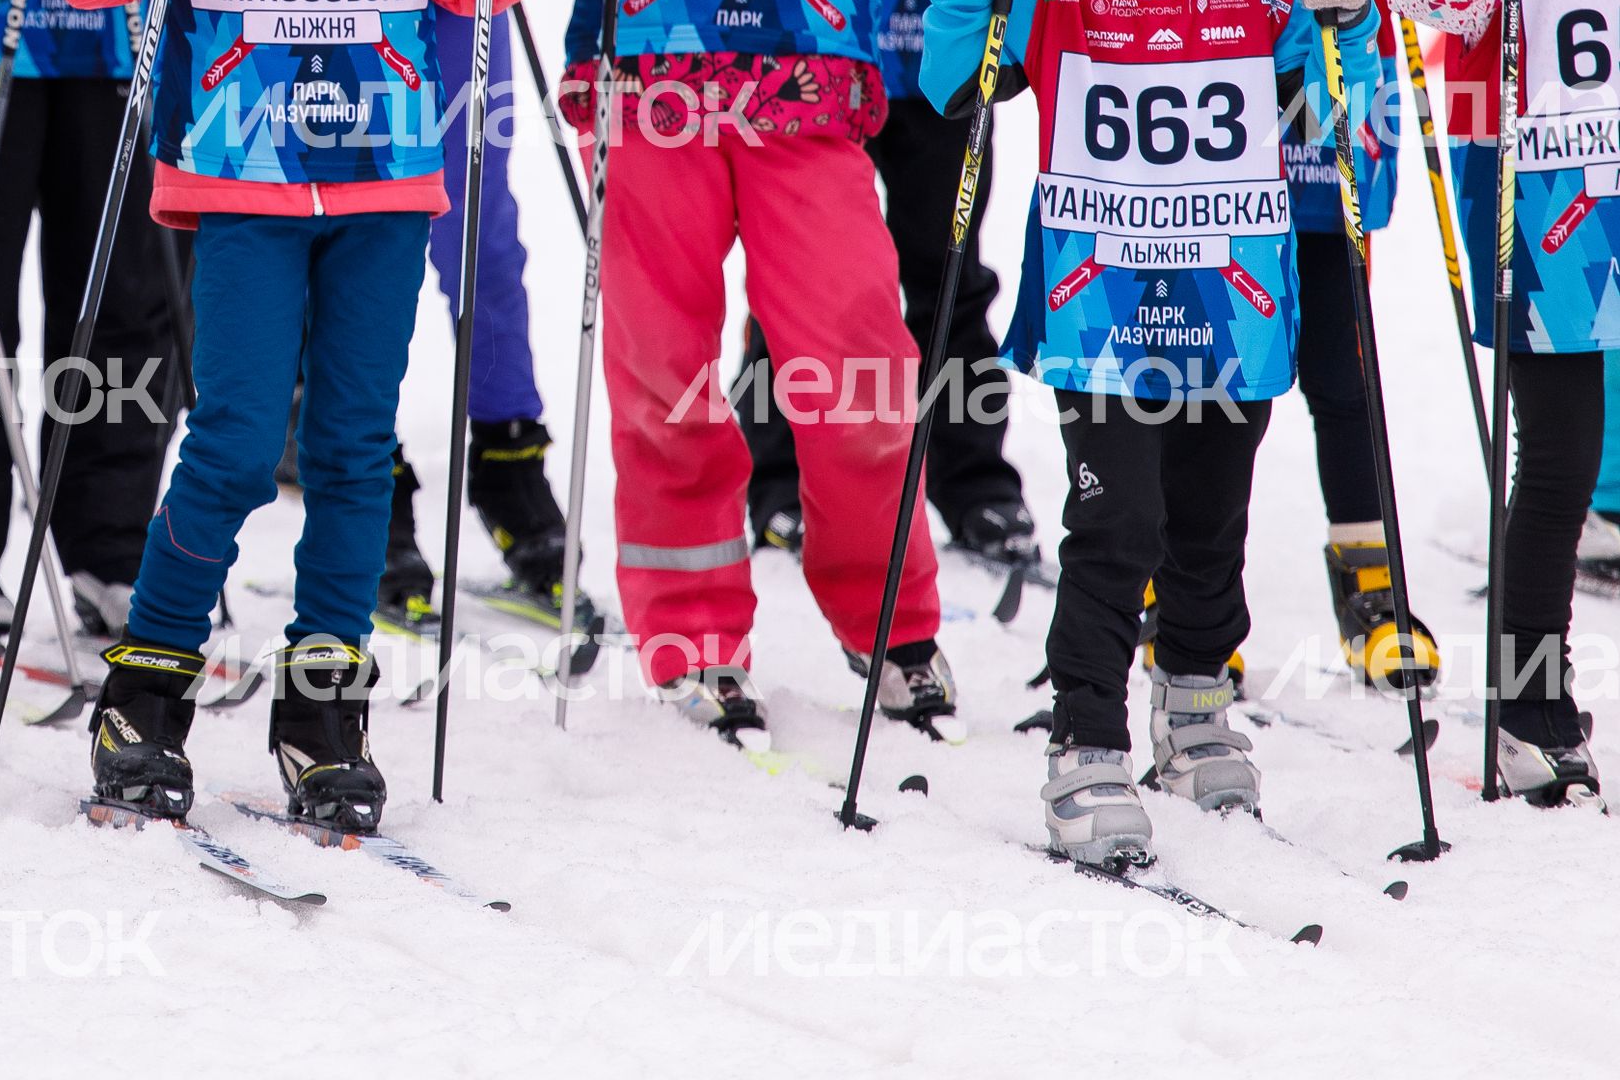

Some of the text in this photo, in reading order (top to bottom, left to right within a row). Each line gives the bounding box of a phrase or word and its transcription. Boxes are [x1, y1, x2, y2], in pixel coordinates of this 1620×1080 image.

[274, 16, 356, 39] ЛЫЖНЯ
[716, 9, 763, 28] ПАРК
[1084, 29, 1134, 42] РАЛХИМ
[1201, 25, 1246, 41] ЗИМА
[293, 82, 340, 102] ПАРК
[264, 98, 369, 123] ЛАЗУТИНОЙ
[1085, 81, 1248, 165] 663
[1040, 182, 1287, 229] МАНЖОСОВСКАЯ
[1120, 241, 1201, 264] ЛЫЖНЯ
[1138, 306, 1185, 325] ПАРК
[1110, 322, 1213, 346] ЛАЗУТИНОЙ
[120, 654, 180, 669] FISCHER
[295, 652, 351, 662] FISCHER
